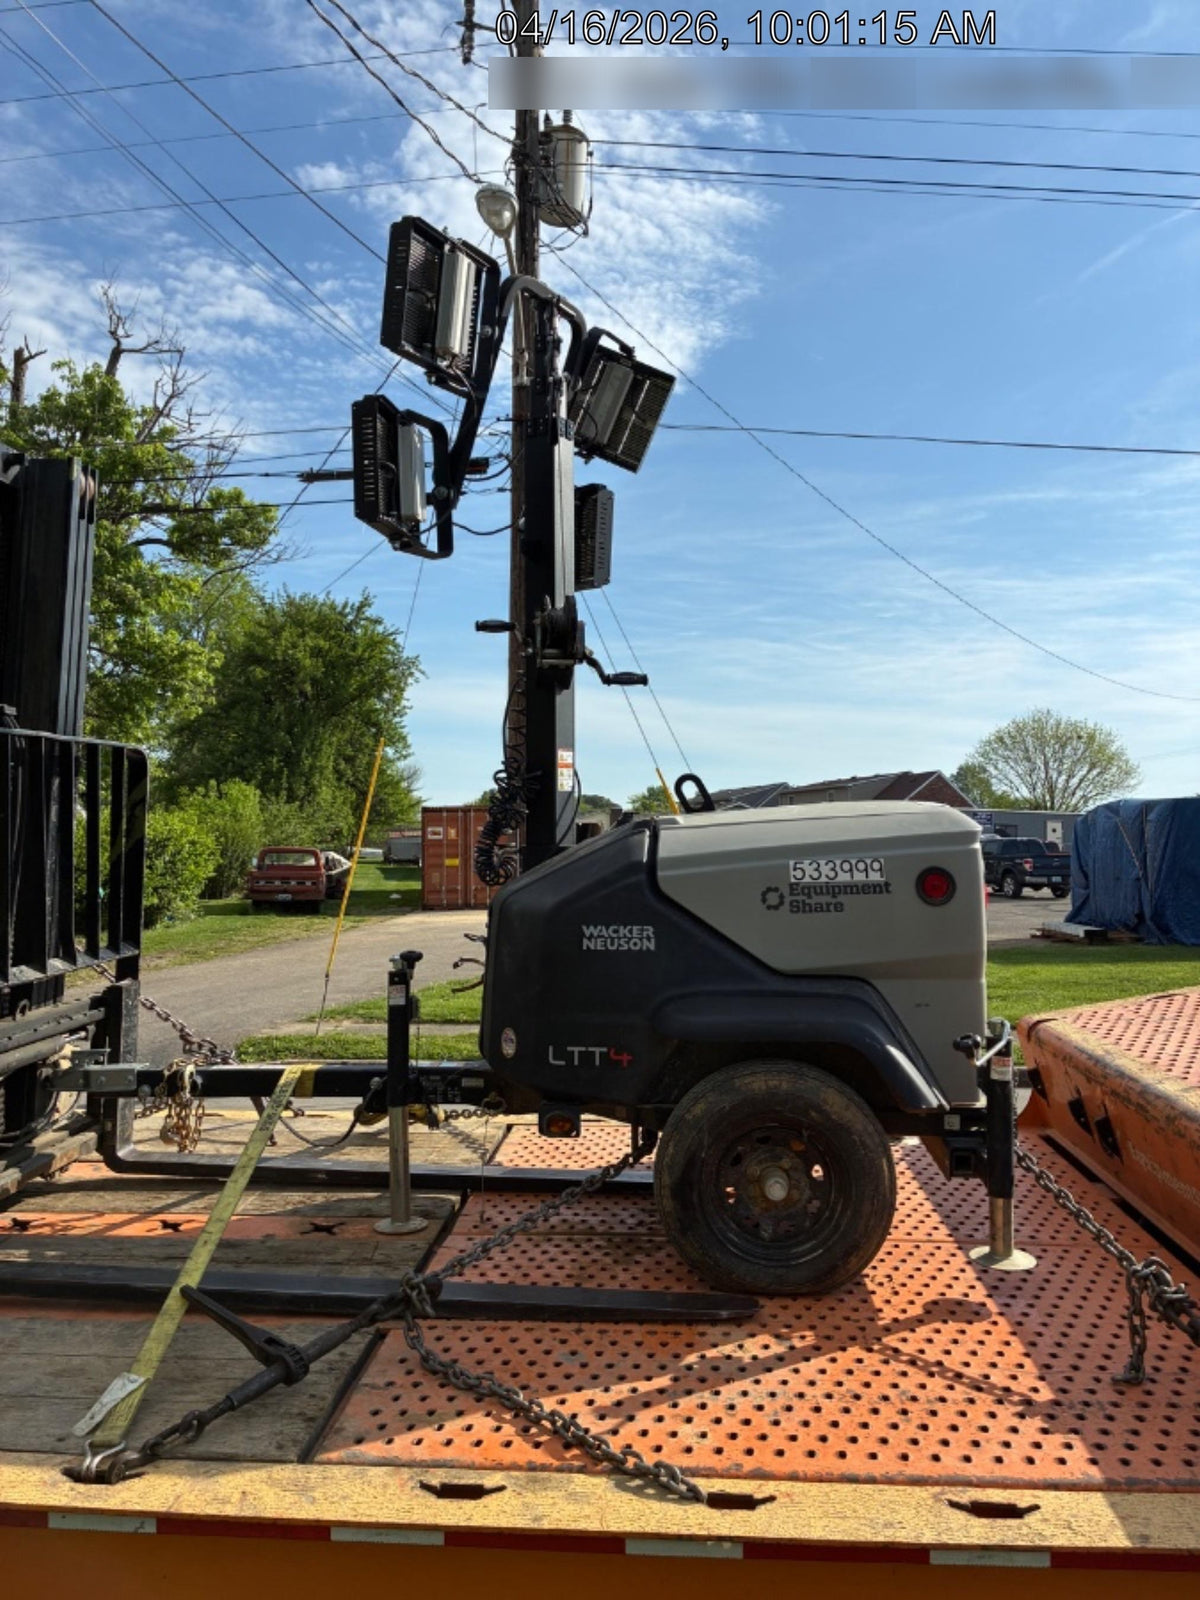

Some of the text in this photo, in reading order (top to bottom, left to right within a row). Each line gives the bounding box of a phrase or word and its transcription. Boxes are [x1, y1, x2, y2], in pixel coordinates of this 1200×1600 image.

[792, 859, 884, 881] 533999
[789, 881, 892, 899] Equipment
[789, 900, 844, 914] Share
[582, 925, 655, 938] WACKER
[582, 938, 655, 950] NEUSON
[549, 1045, 632, 1067] LTT4
